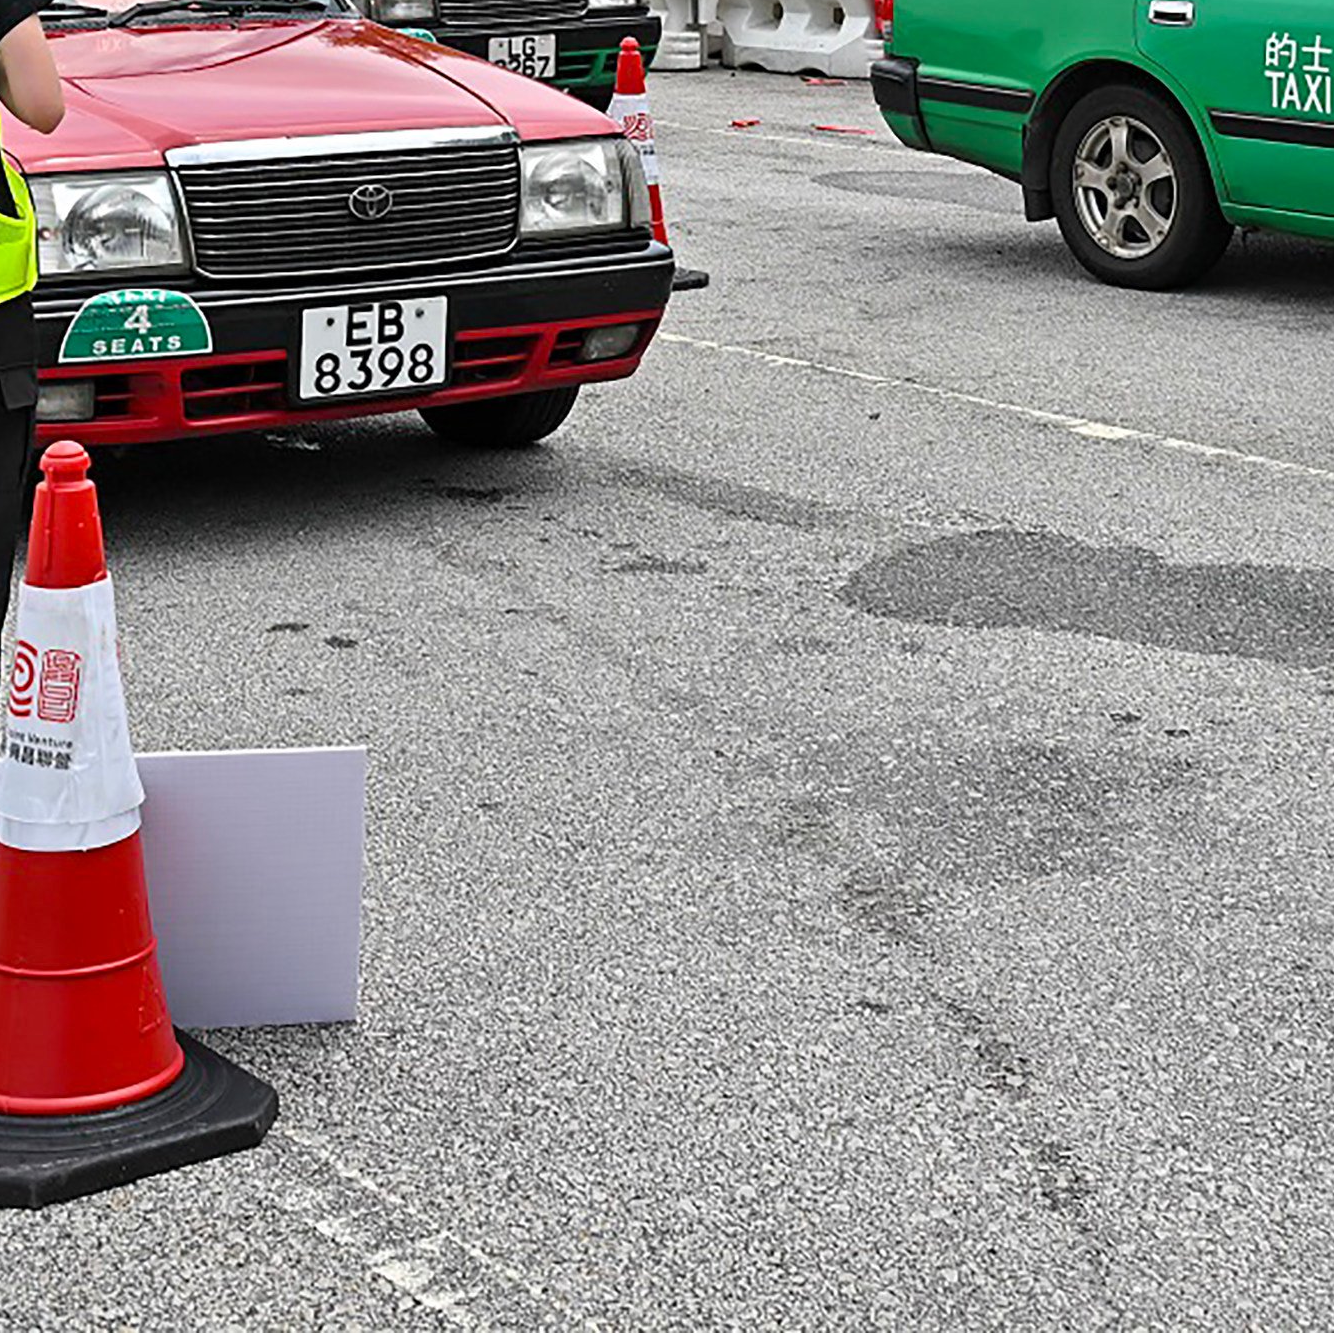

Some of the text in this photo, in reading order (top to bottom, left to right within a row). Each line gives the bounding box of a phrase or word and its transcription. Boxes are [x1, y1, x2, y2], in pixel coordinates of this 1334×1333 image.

[508, 38, 536, 58] LG
[1265, 31, 1332, 73] 的士
[1264, 70, 1331, 114] TAXI
[124, 304, 152, 334] 4
[346, 301, 405, 347] EB
[92, 335, 181, 355] SEATS
[314, 343, 434, 395] 8398
